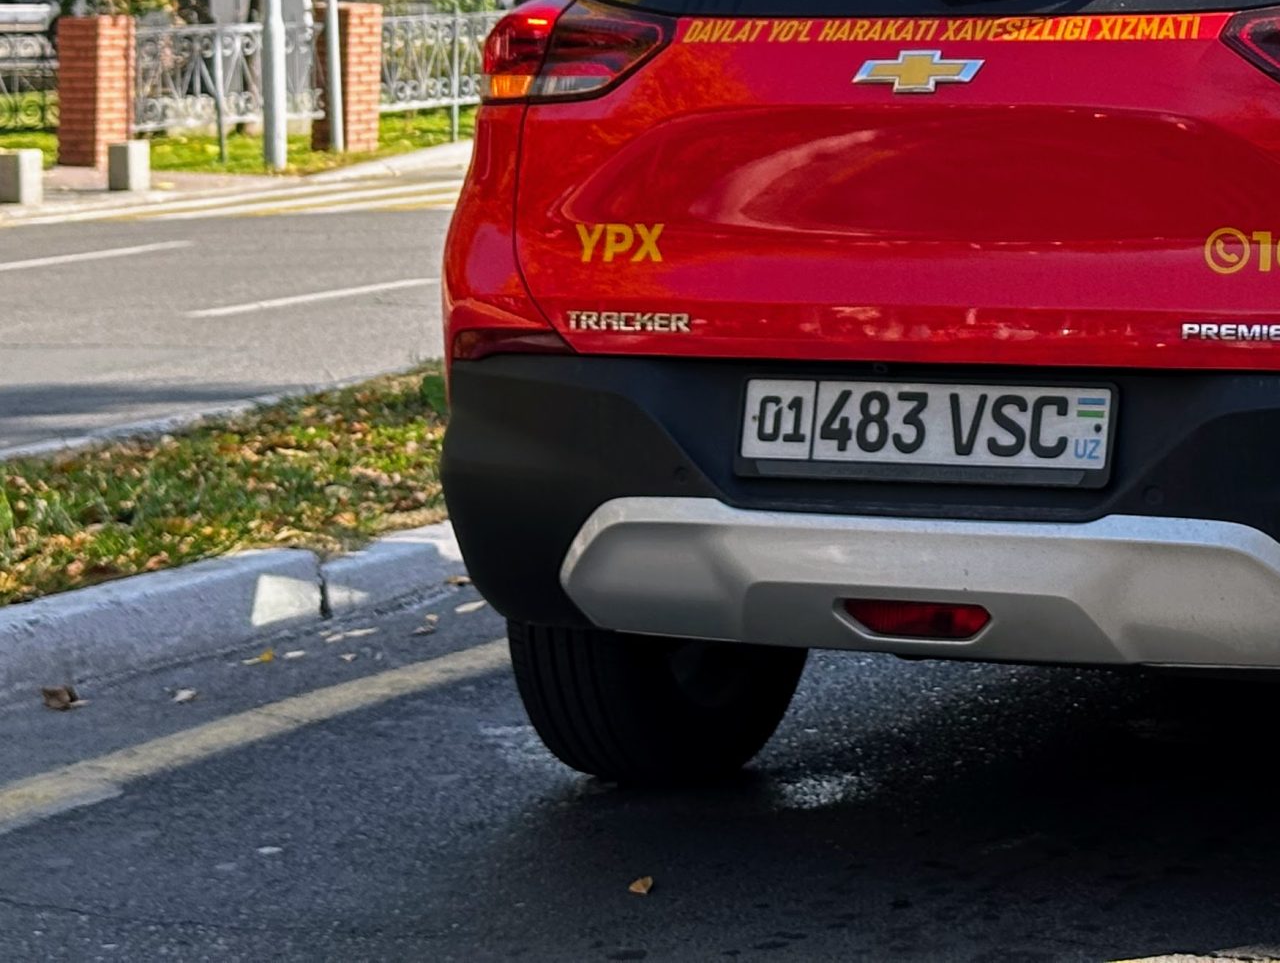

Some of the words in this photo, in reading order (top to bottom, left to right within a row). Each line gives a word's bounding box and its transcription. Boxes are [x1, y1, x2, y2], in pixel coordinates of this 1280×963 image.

[682, 20, 769, 43] DAVLAT
[817, 20, 940, 42] HARAKATI
[1094, 15, 1201, 41] XIZMATI
[575, 223, 665, 263] YPX
[566, 310, 691, 332] TRACKER
[756, 394, 806, 443] 01
[820, 389, 929, 454] 483
[949, 392, 1069, 459] VSC
[1074, 438, 1101, 461] UZ
